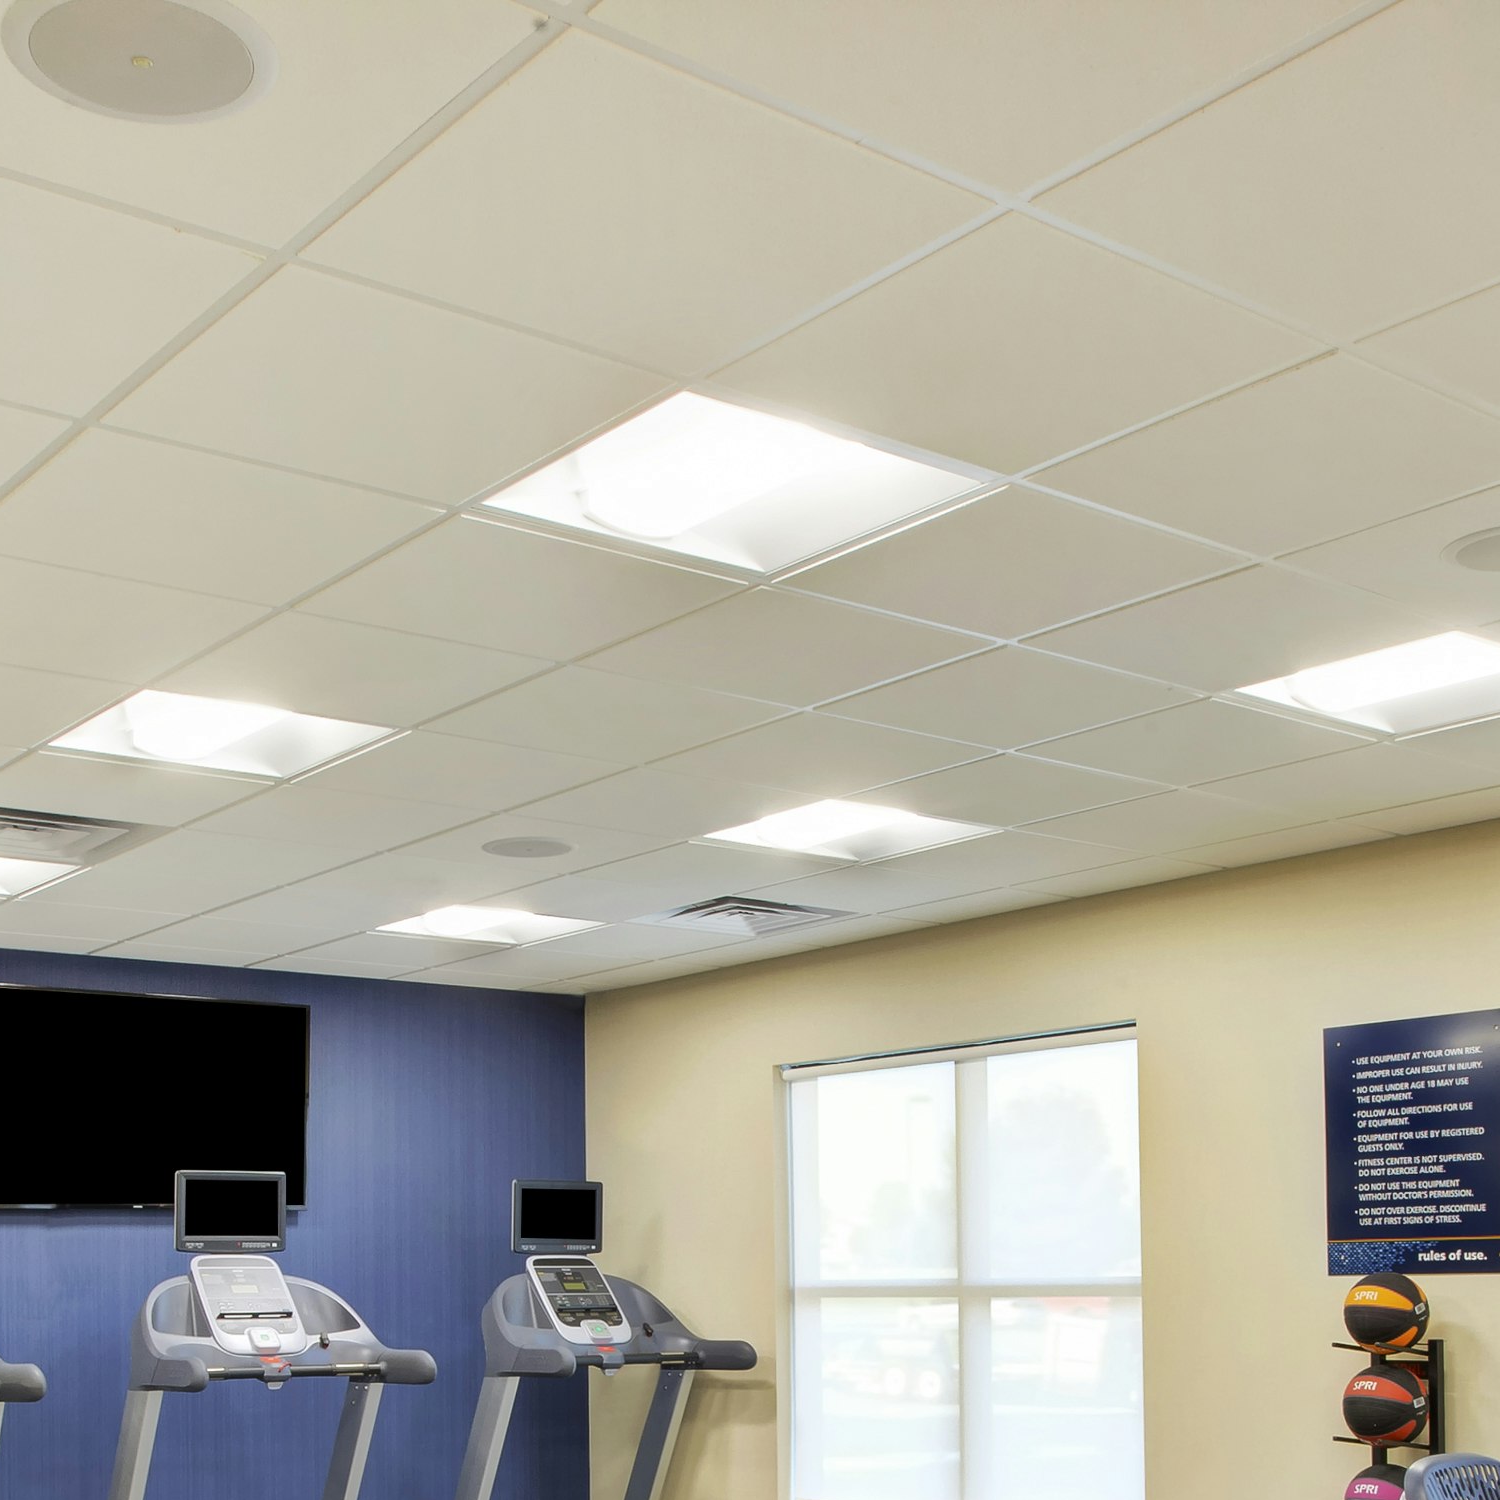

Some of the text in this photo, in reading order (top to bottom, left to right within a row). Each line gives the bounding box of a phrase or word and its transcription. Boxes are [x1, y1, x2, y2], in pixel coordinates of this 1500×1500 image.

[1356, 1057, 1369, 1065] USE
[1371, 1053, 1411, 1064] EQUIPMENT
[1422, 1050, 1443, 1058] YOUR
[1444, 1048, 1463, 1057] OWN
[1465, 1046, 1483, 1054] RISK.
[1356, 1069, 1390, 1079] IMPROPER
[1392, 1068, 1404, 1076] USE
[1406, 1067, 1420, 1075] CAN
[1422, 1064, 1447, 1073] RESULT
[1457, 1061, 1483, 1070] INJURY.
[1357, 1086, 1367, 1094] NO
[1369, 1085, 1384, 1093] ONE
[1385, 1082, 1409, 1092] UNDER
[1427, 1080, 1435, 1088] 18
[1437, 1079, 1454, 1087] MAY
[1455, 1077, 1469, 1085] USE
[1372, 1092, 1413, 1103] EQUIPMENT.
[1357, 1109, 1387, 1118] FOLLOW
[1387, 1108, 1400, 1116] ALL
[1401, 1105, 1442, 1115] DIRECTIONS
[1460, 1102, 1473, 1110] USE
[1368, 1117, 1410, 1128] EQUIPMENT.
[1358, 1132, 1398, 1143] EQUIPMENT
[1430, 1130, 1440, 1138] BY
[1442, 1127, 1485, 1137] REGISTERED
[1358, 1143, 1404, 1152] GUESTS ONLY.
[1358, 1153, 1484, 1167] FITNESS CENTER IS NOT SUPERVISED.
[1359, 1165, 1446, 1177] DO NOT EXERCISE ALONE.
[1371, 1183, 1386, 1191] NOT
[1387, 1182, 1400, 1190] USE
[1418, 1179, 1460, 1189] EQUIPMENT
[1359, 1190, 1474, 1201] WITHOUT DOCTOR'S PERMISSION.
[1359, 1208, 1370, 1216] DO
[1406, 1206, 1438, 1214] EXERCISE.
[1440, 1204, 1486, 1213] DISCONTINUE
[1360, 1218, 1372, 1226] USE
[1384, 1217, 1401, 1225] FIRST
[1403, 1216, 1423, 1224] SIGNS
[1435, 1215, 1462, 1223] STRESS.
[1418, 1250, 1487, 1261] rules of use.
[1354, 1291, 1378, 1301] SPRI
[1353, 1381, 1378, 1391] SPRI
[1354, 1484, 1378, 1495] SPRI
